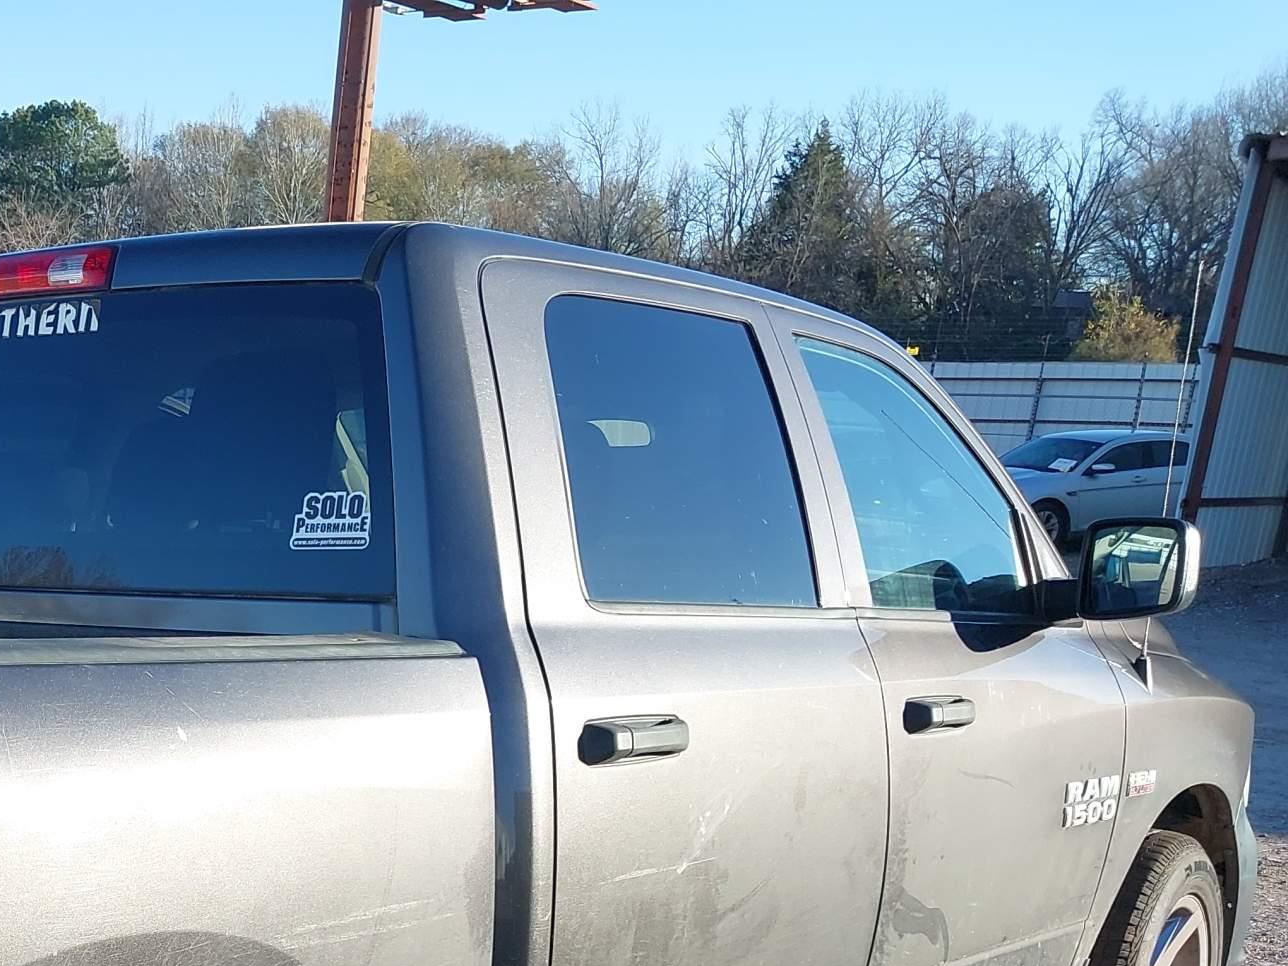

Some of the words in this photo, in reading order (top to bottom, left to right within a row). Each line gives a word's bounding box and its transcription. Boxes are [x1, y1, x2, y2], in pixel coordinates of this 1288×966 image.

[304, 493, 366, 520] SOLO
[1065, 775, 1120, 805] RAM
[1062, 798, 1116, 829] 1500
